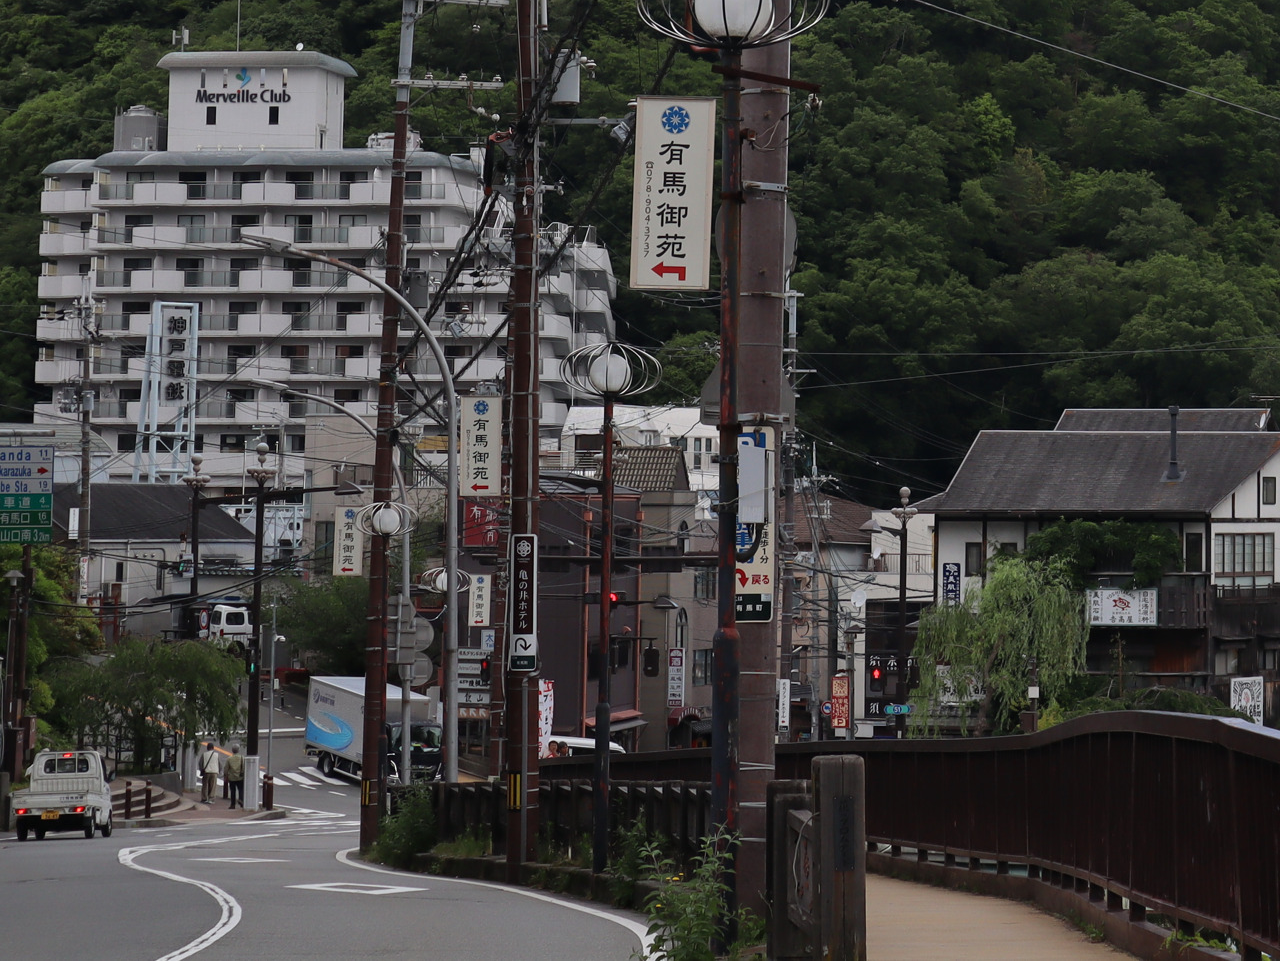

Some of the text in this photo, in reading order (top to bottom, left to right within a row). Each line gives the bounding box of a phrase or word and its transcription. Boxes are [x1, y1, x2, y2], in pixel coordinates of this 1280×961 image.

[195, 89, 291, 103] Merveille Club
[656, 140, 690, 259] 有馬御苑
[165, 315, 187, 401] 神戸電鉄
[39, 449, 48, 457] 11
[472, 418, 490, 480] 有馬御苑
[39, 480, 48, 489] 19
[39, 496, 45, 504] 4
[342, 521, 355, 565] 有馬御苑
[751, 574, 770, 585] 戻る
[474, 585, 485, 619] 有馬御苑
[518, 569, 529, 629] 亀の井ホテル
[736, 604, 763, 612] 有馬町
[894, 705, 901, 713] 51
